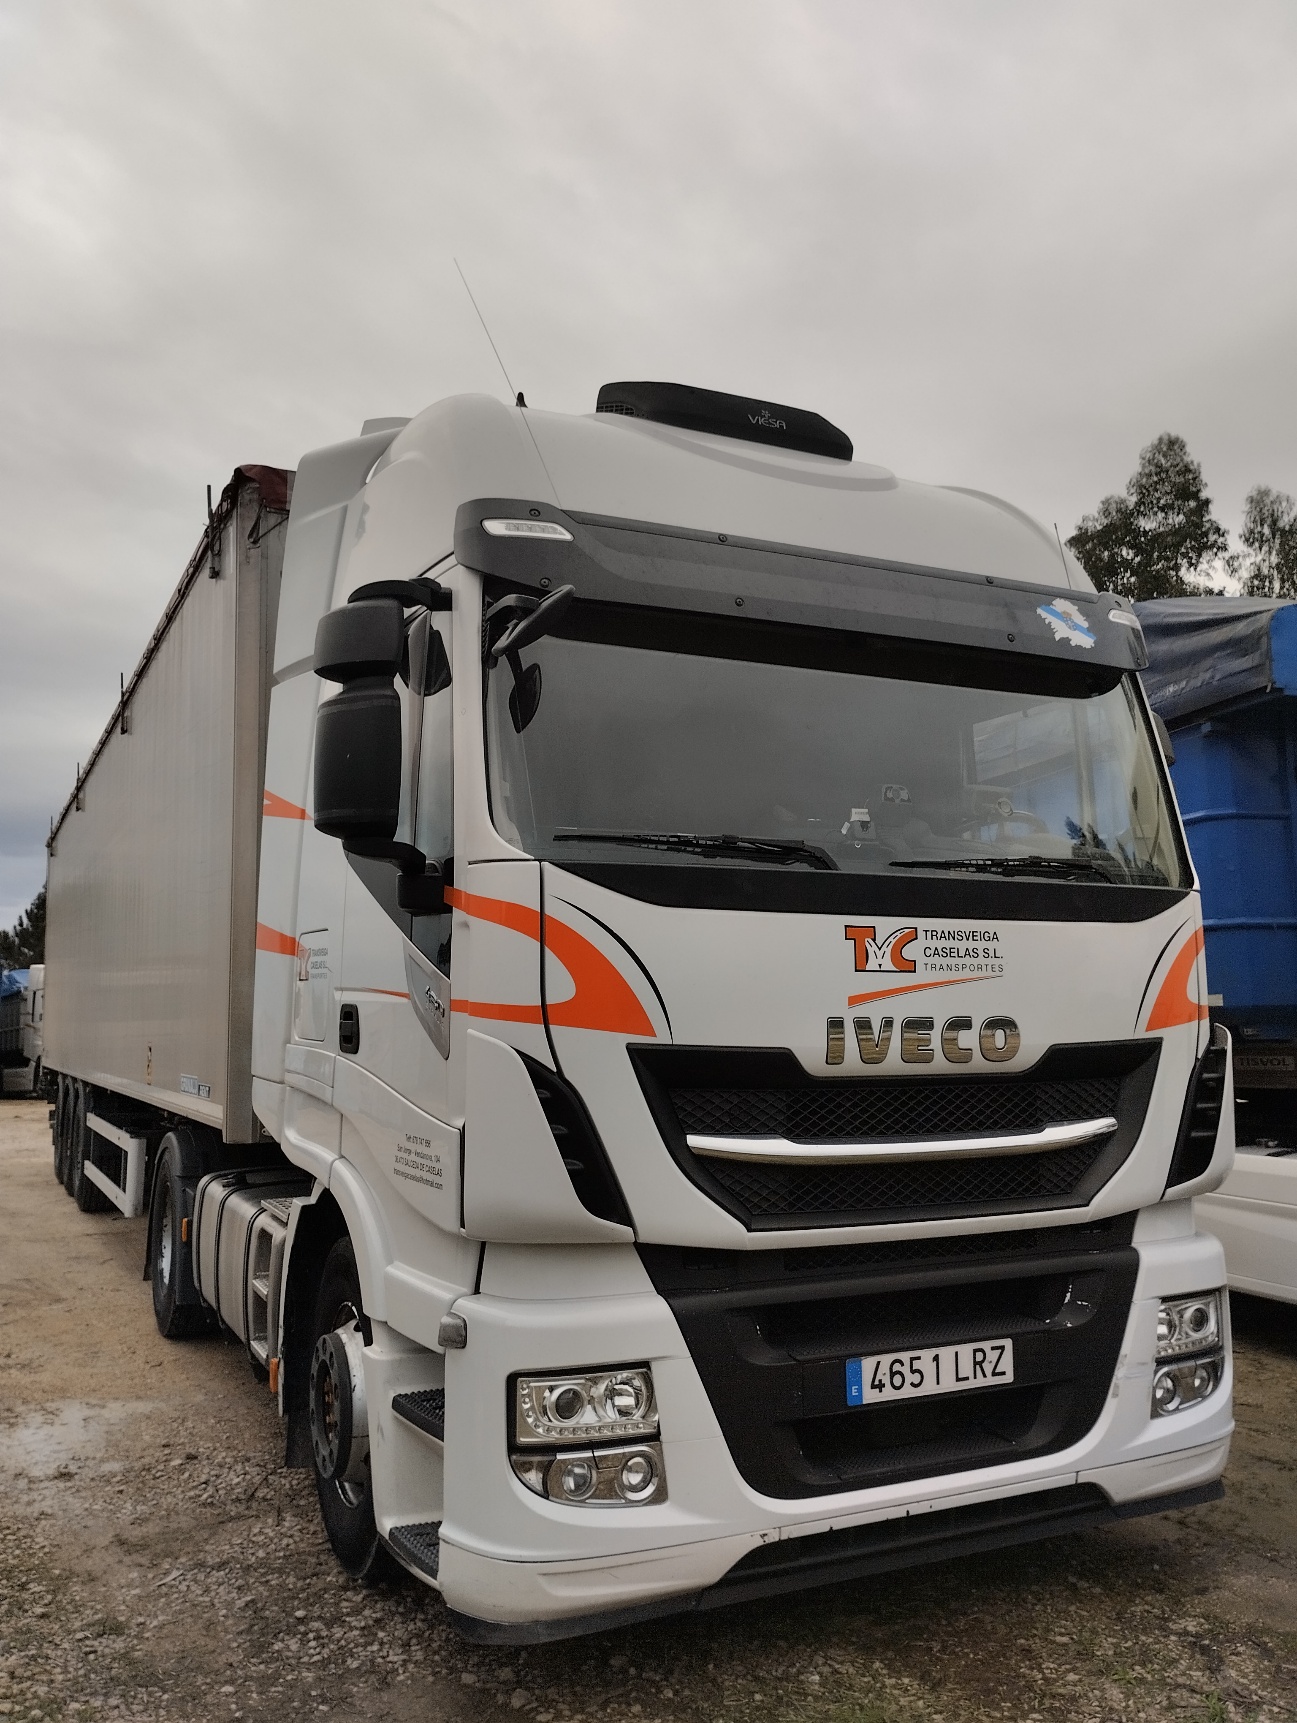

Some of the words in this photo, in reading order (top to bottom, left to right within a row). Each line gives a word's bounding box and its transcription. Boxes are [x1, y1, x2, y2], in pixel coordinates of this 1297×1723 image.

[748, 414, 786, 430] VIESA
[922, 929, 1000, 943] TRANSVEIGA
[923, 946, 980, 959] CASELAS
[982, 947, 1004, 960] S.L.
[923, 963, 1004, 973] TRANSPORTES
[825, 1015, 1021, 1065] IVECO
[851, 1385, 859, 1396] E
[870, 1353, 941, 1393] 4651
[954, 1344, 1007, 1383] LRZ
